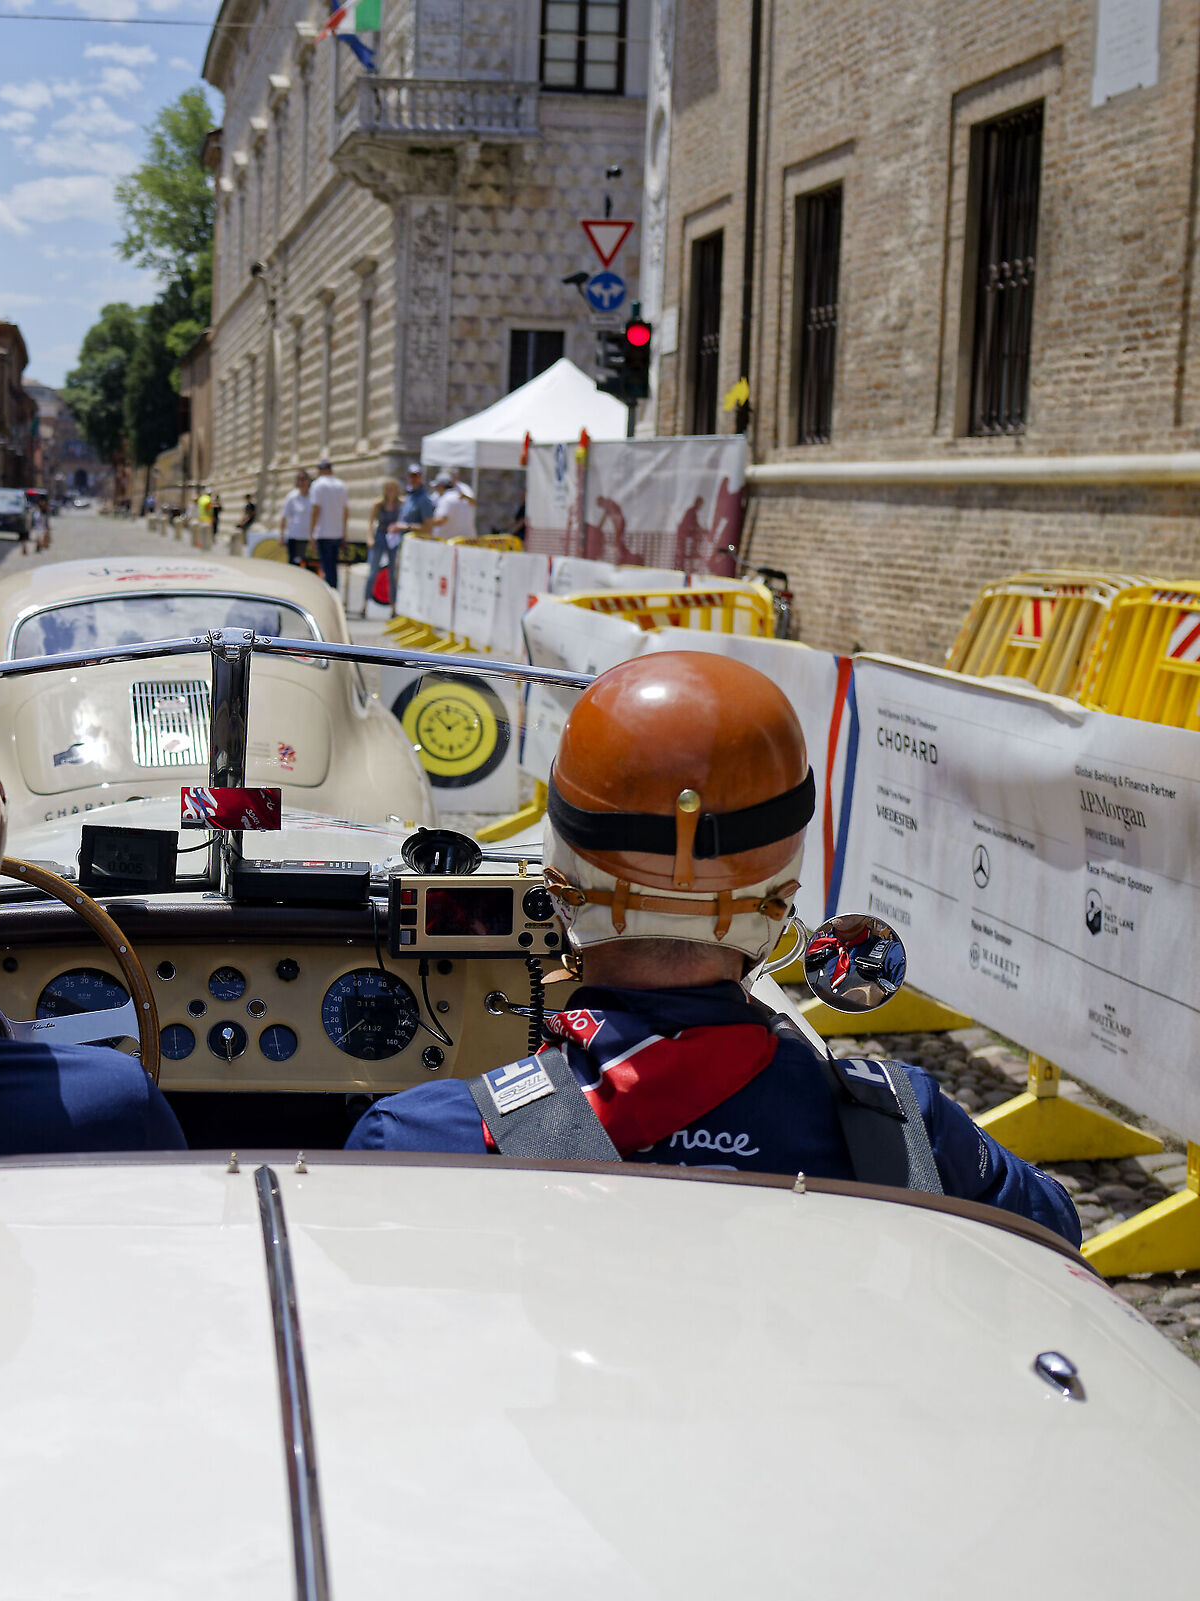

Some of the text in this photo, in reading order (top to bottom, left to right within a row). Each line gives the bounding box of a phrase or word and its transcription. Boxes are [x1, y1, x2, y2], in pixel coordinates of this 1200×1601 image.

[877, 727, 938, 765] CHOPARD
[1094, 769, 1118, 788] Banking
[1124, 777, 1149, 793] Finance
[1150, 784, 1176, 799] Partner
[1100, 867, 1126, 885] Premium
[1127, 877, 1153, 894] Sponsor
[669, 1129, 760, 1156] race
